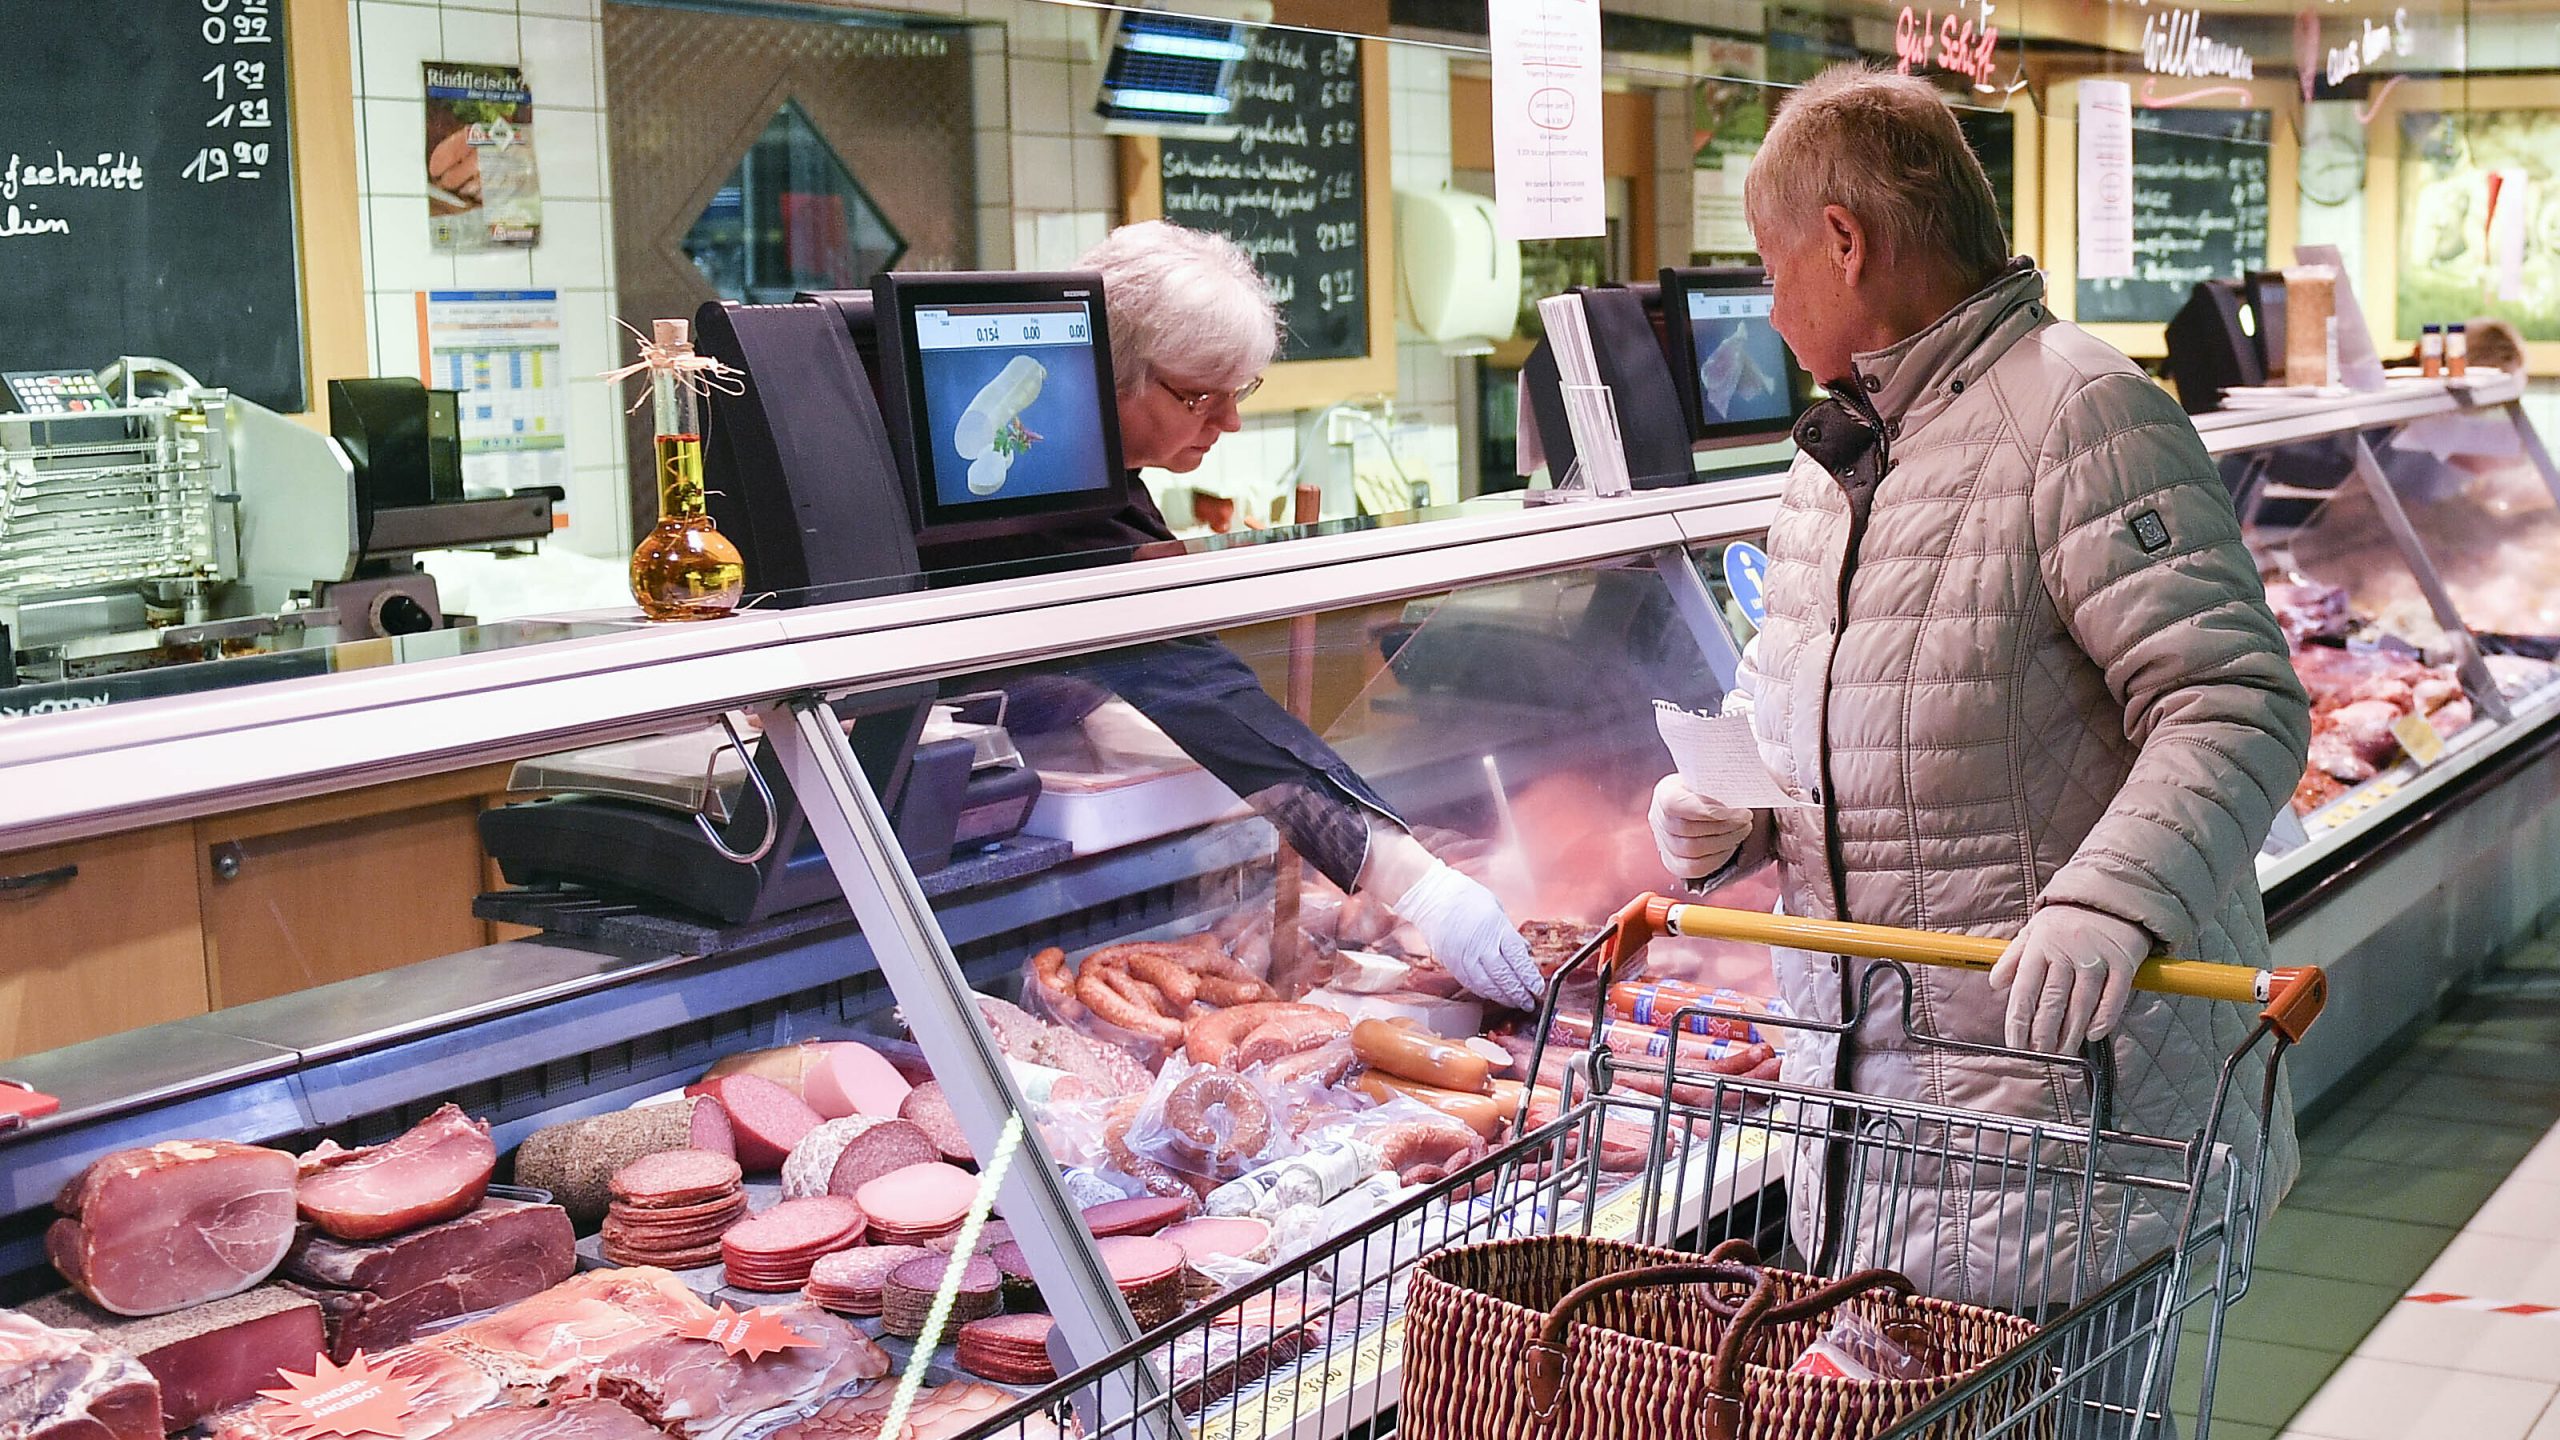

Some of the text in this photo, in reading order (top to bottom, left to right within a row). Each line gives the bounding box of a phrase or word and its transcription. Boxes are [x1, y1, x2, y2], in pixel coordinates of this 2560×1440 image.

[2142, 8, 2254, 81] Willkommen
[2327, 40, 2360, 87] aus
[0, 150, 144, 200] fschnitt
[976, 327, 999, 342] 0.154
[1023, 325, 1041, 340] 0.00
[1068, 324, 1086, 339] 0.00
[300, 1379, 368, 1409] SONDER-
[312, 1386, 384, 1418] ANGEBOT
